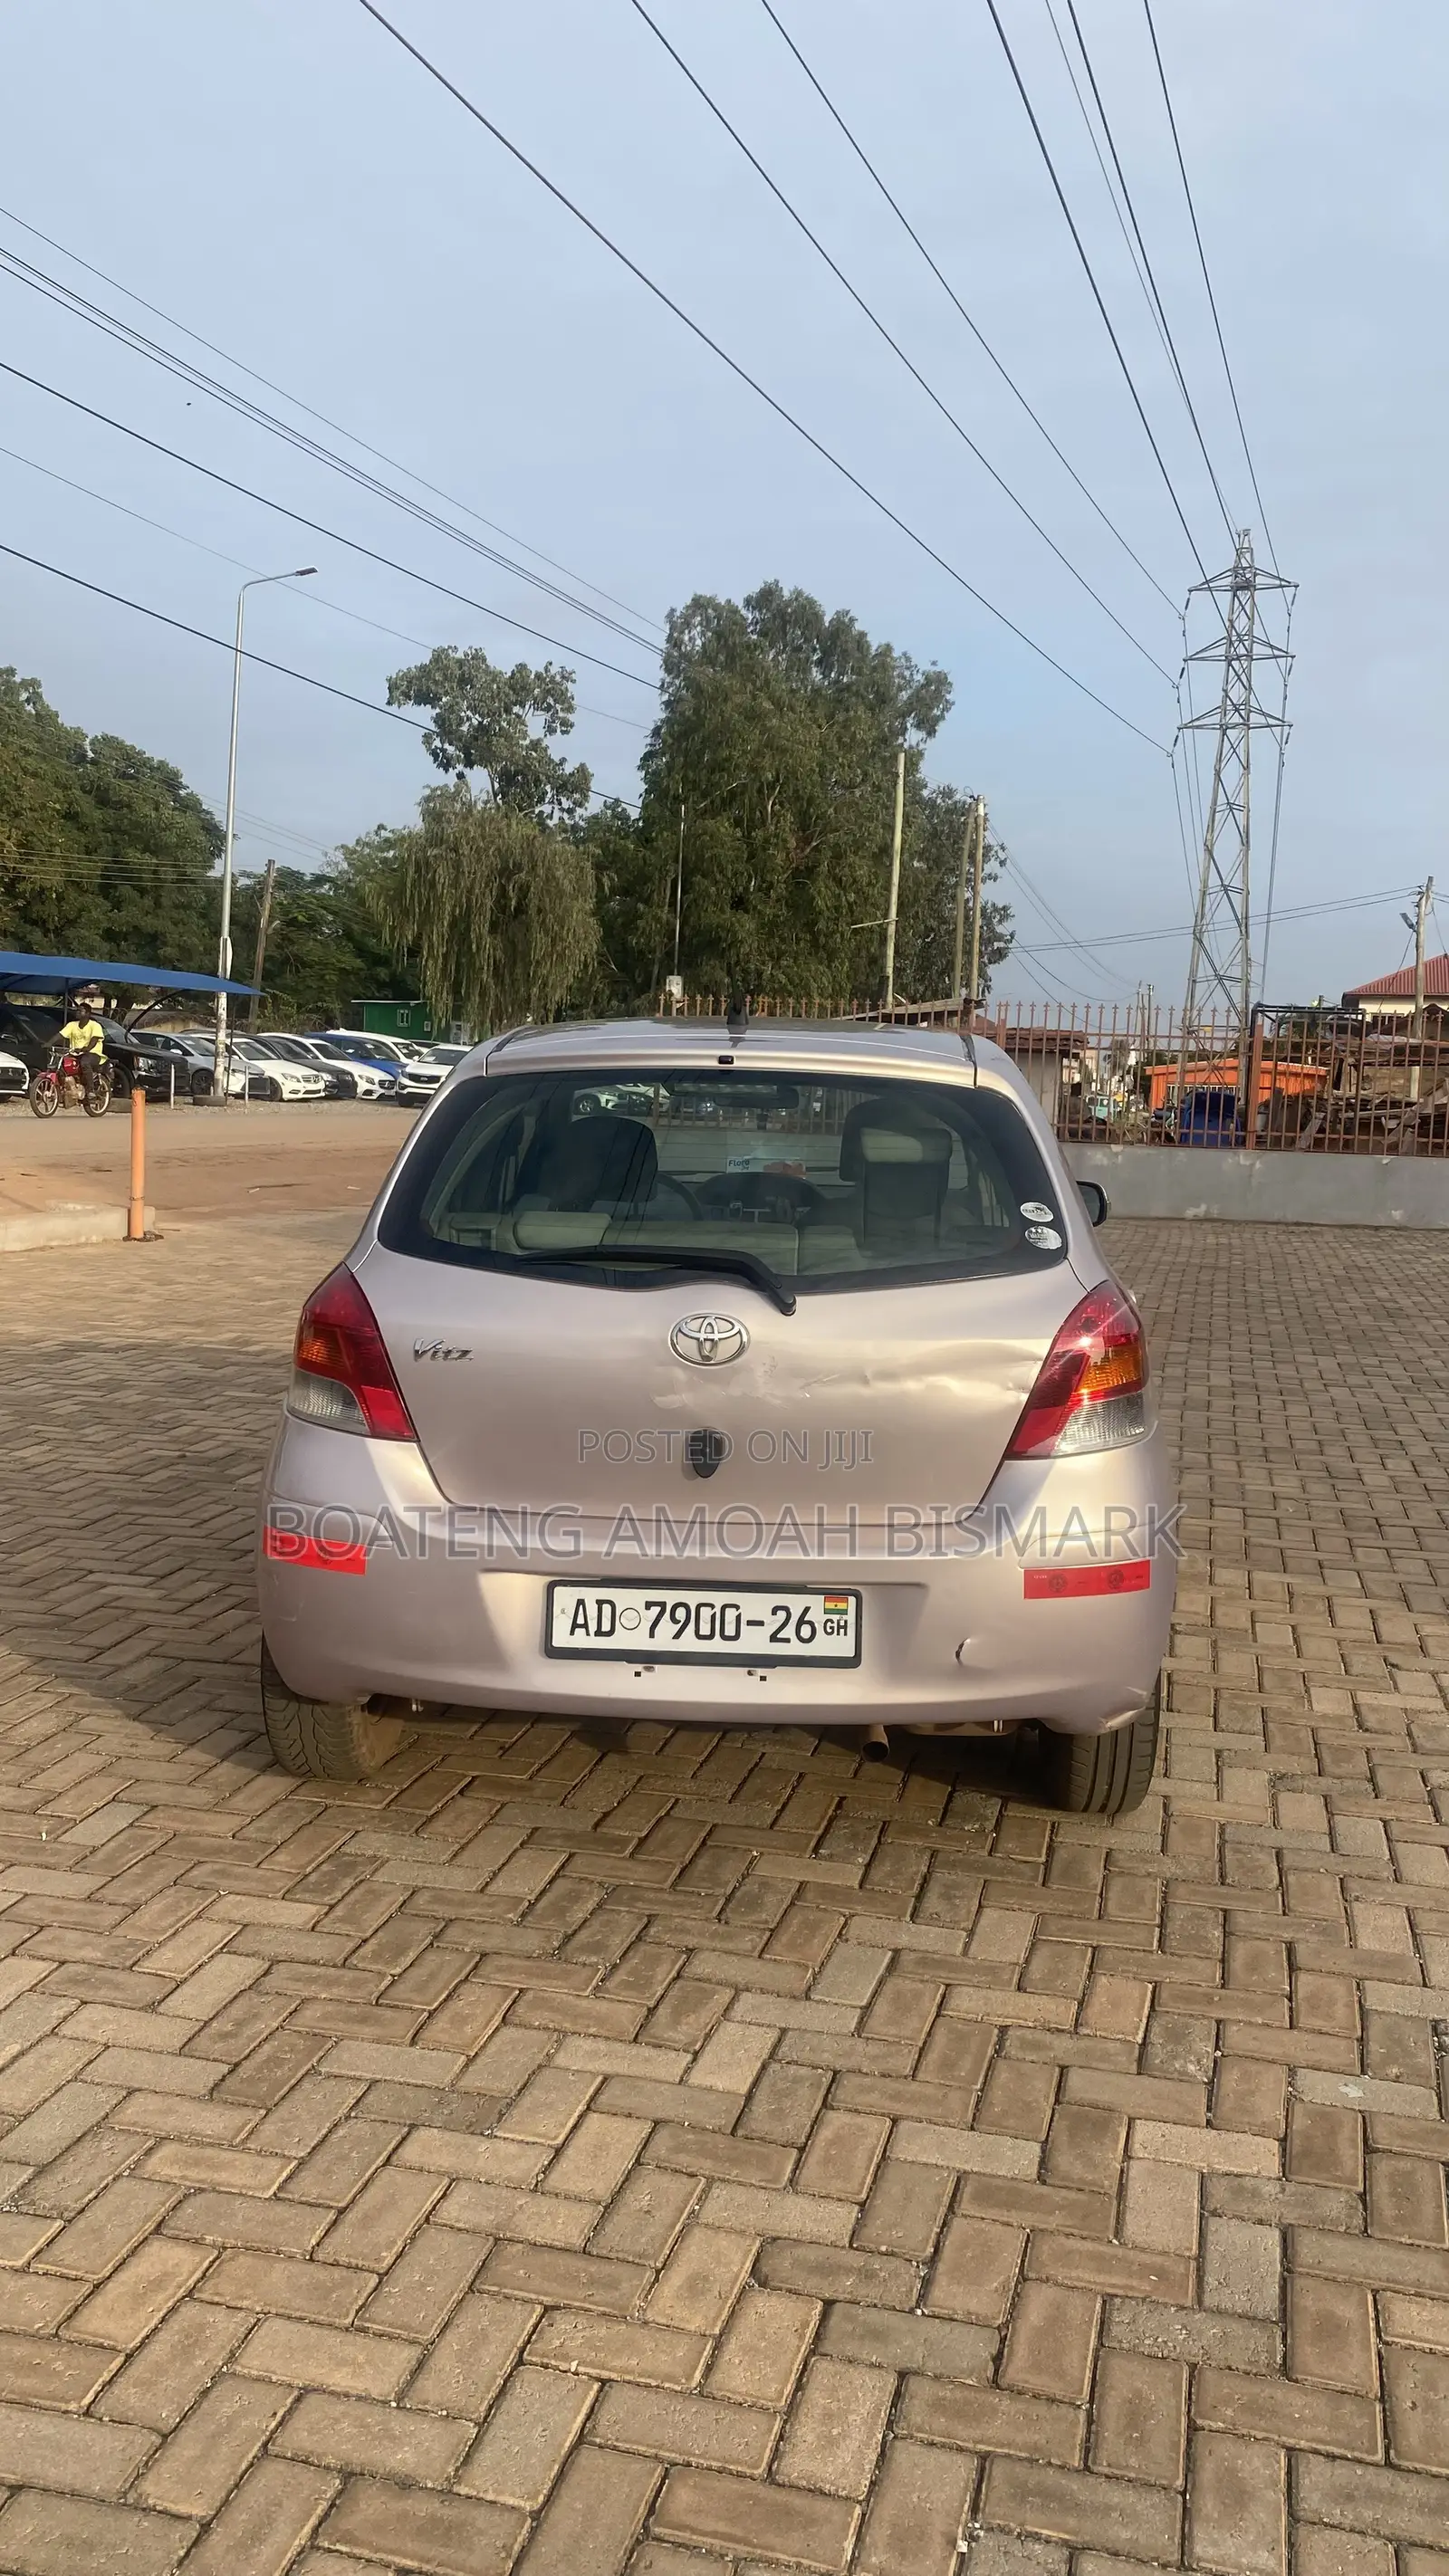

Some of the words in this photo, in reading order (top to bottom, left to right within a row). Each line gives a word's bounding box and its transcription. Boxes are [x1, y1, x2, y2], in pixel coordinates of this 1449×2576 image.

[413, 1337, 475, 1362] Vitz
[569, 1598, 617, 1638] AD
[644, 1600, 818, 1644] 7900-26
[822, 1617, 849, 1637] GH
